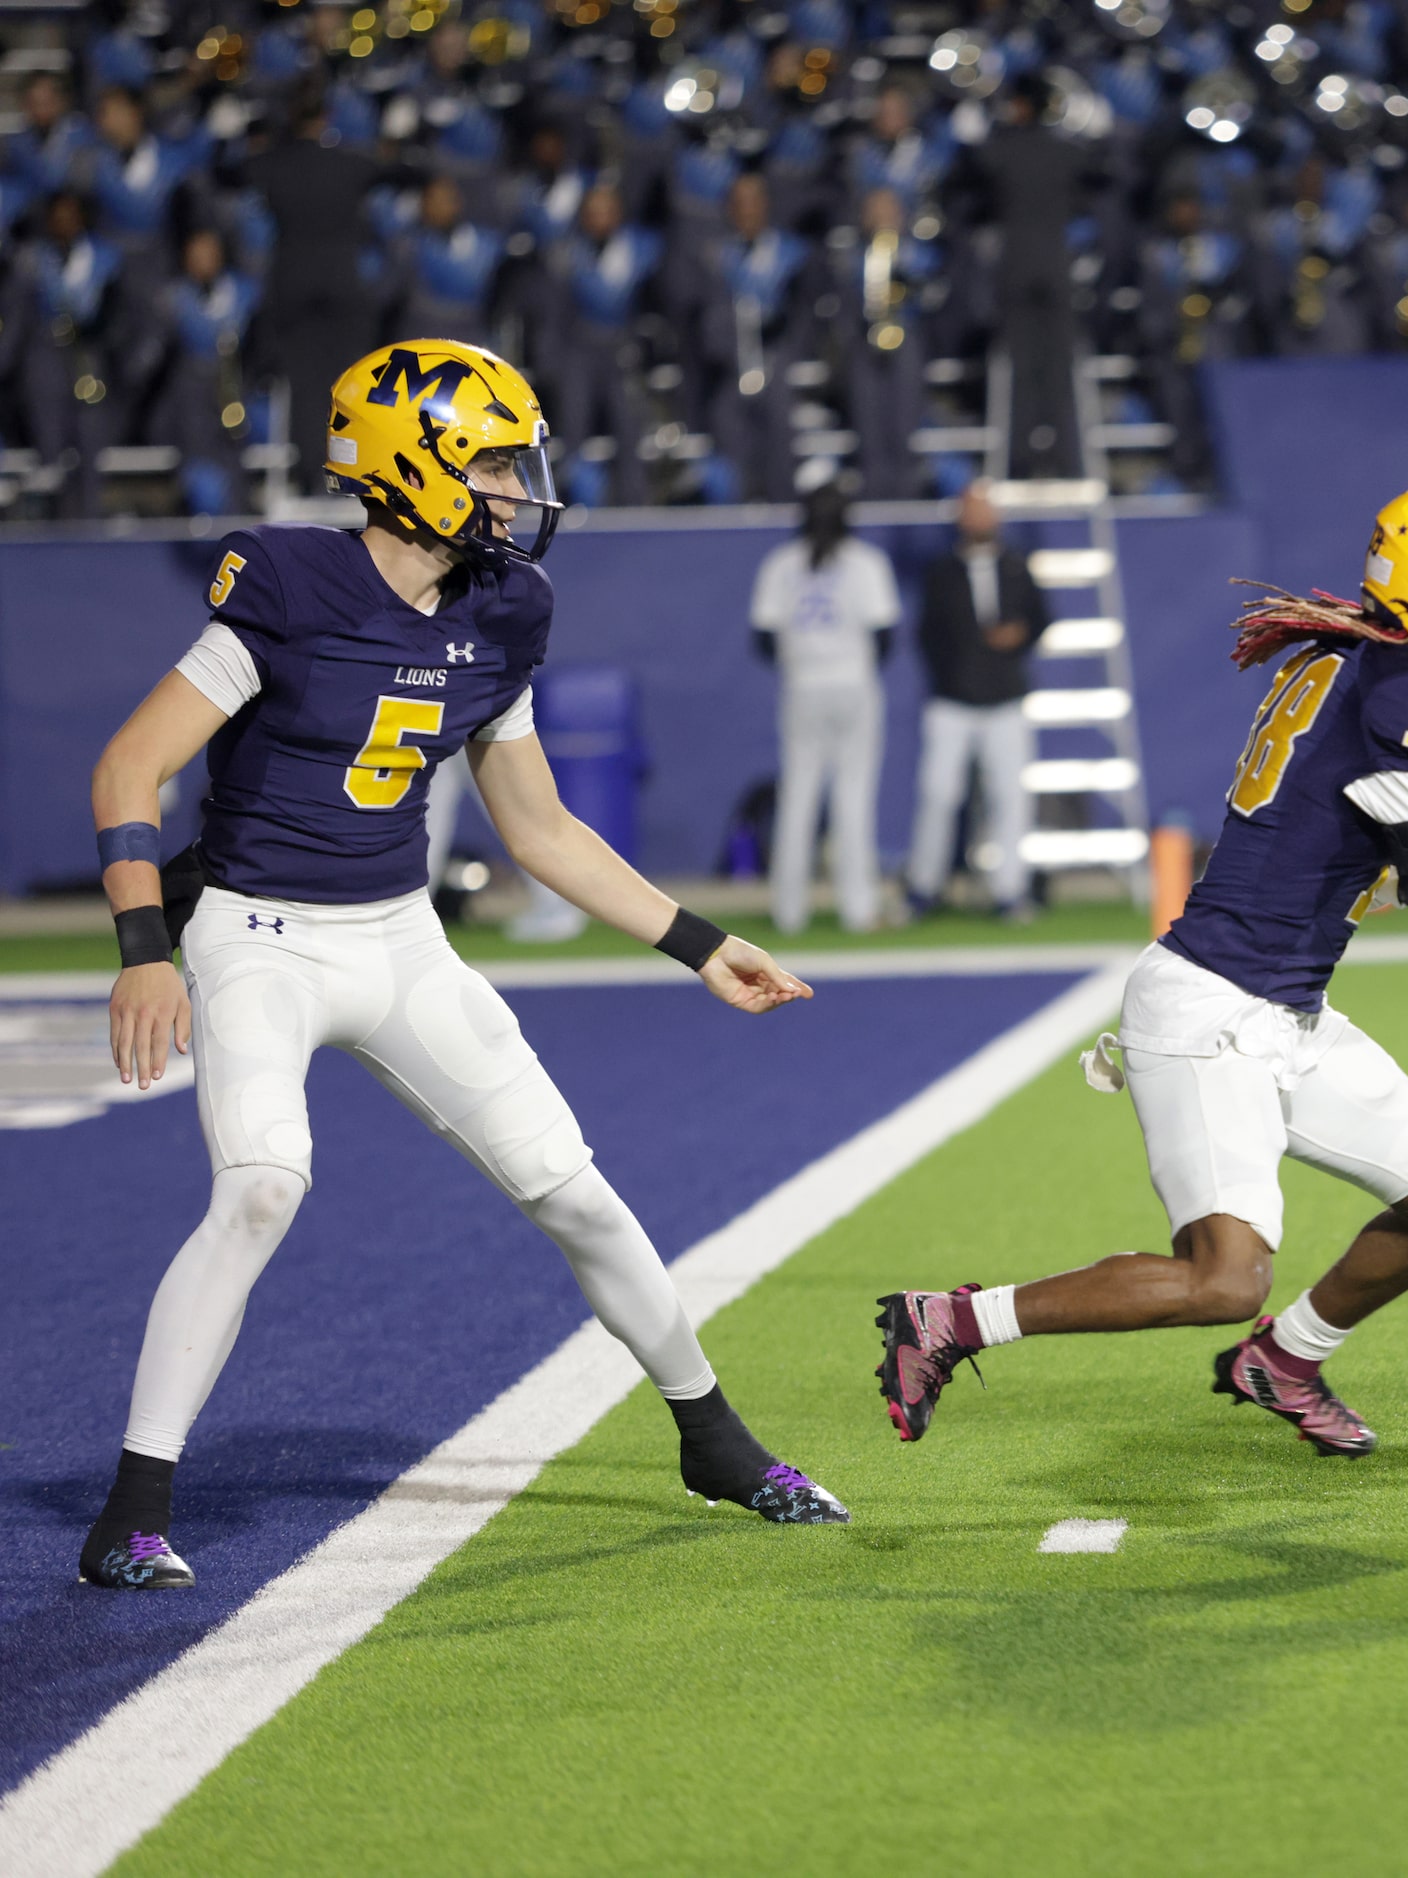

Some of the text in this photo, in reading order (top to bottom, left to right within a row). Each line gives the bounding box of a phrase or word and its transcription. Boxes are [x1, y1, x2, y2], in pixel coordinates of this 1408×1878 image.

[366, 348, 473, 424] M
[209, 549, 248, 608] 5
[394, 666, 448, 687] LIONS
